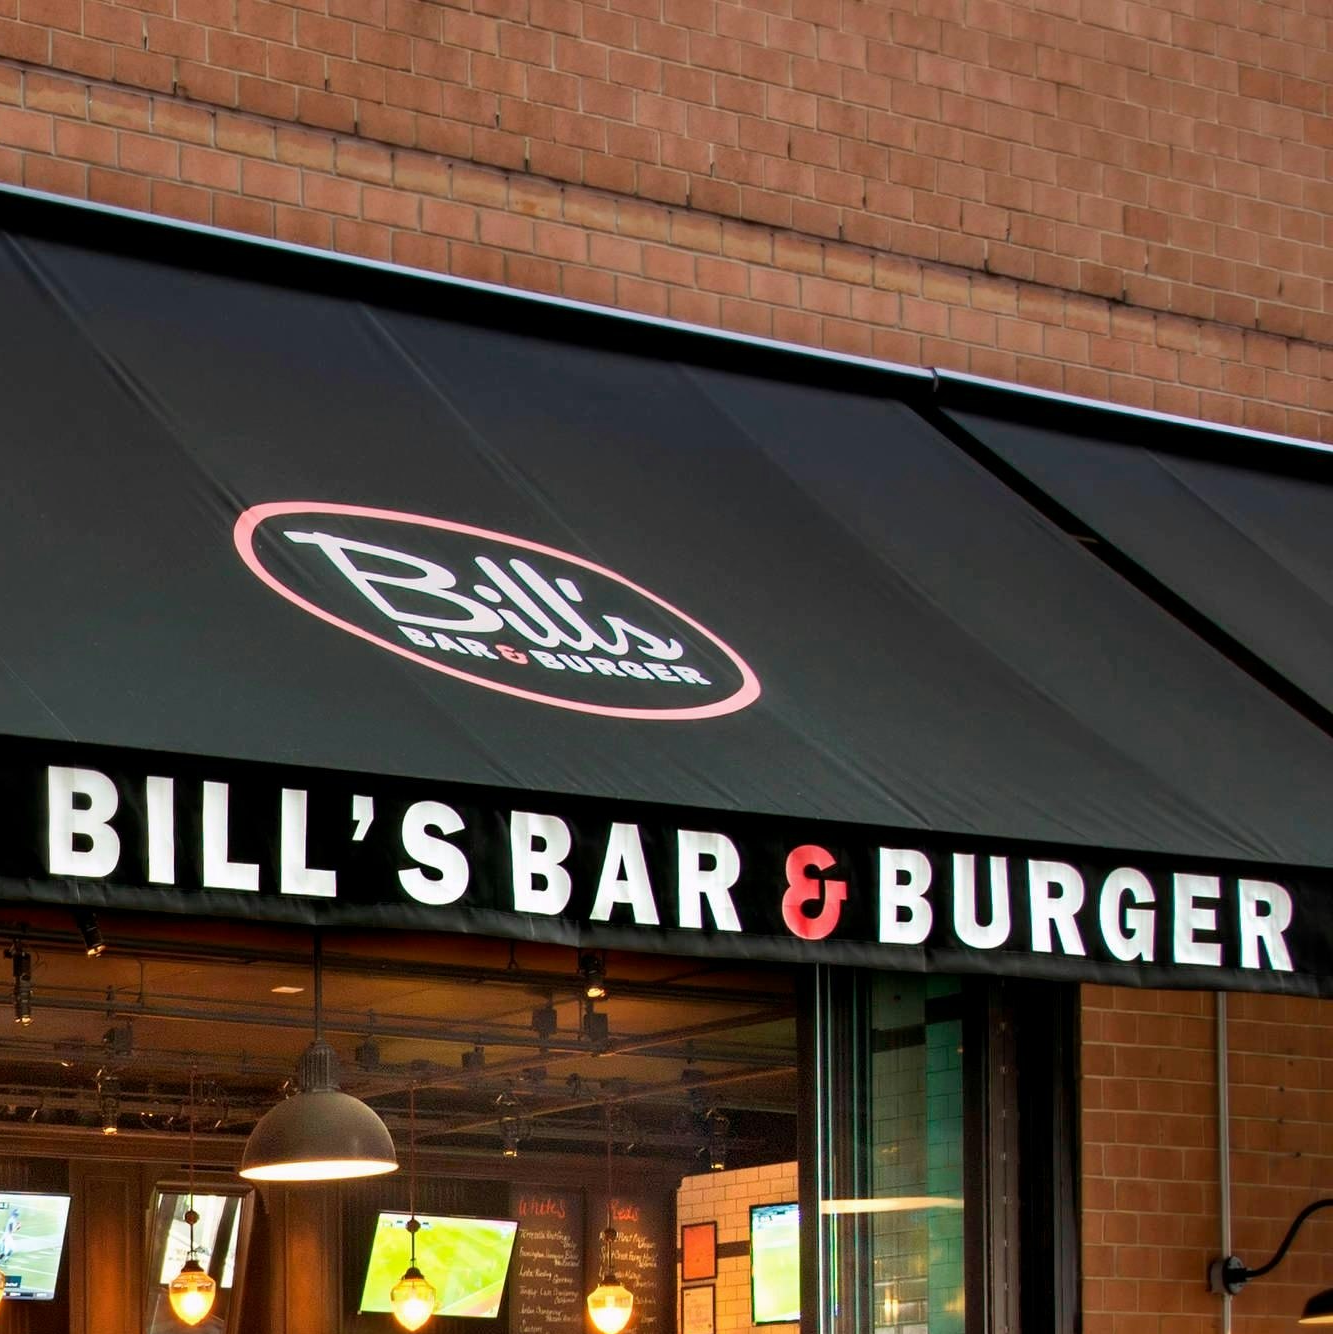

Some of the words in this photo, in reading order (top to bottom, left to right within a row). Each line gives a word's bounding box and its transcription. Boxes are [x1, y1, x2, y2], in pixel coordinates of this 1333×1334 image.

[283, 530, 684, 660] Bill's
[396, 624, 500, 661] BAR
[494, 643, 530, 665] &
[527, 648, 713, 686] BURGER
[47, 763, 471, 908] BILL'S
[509, 809, 743, 934] BAR
[780, 843, 849, 941] &
[875, 846, 1295, 974] BURGER
